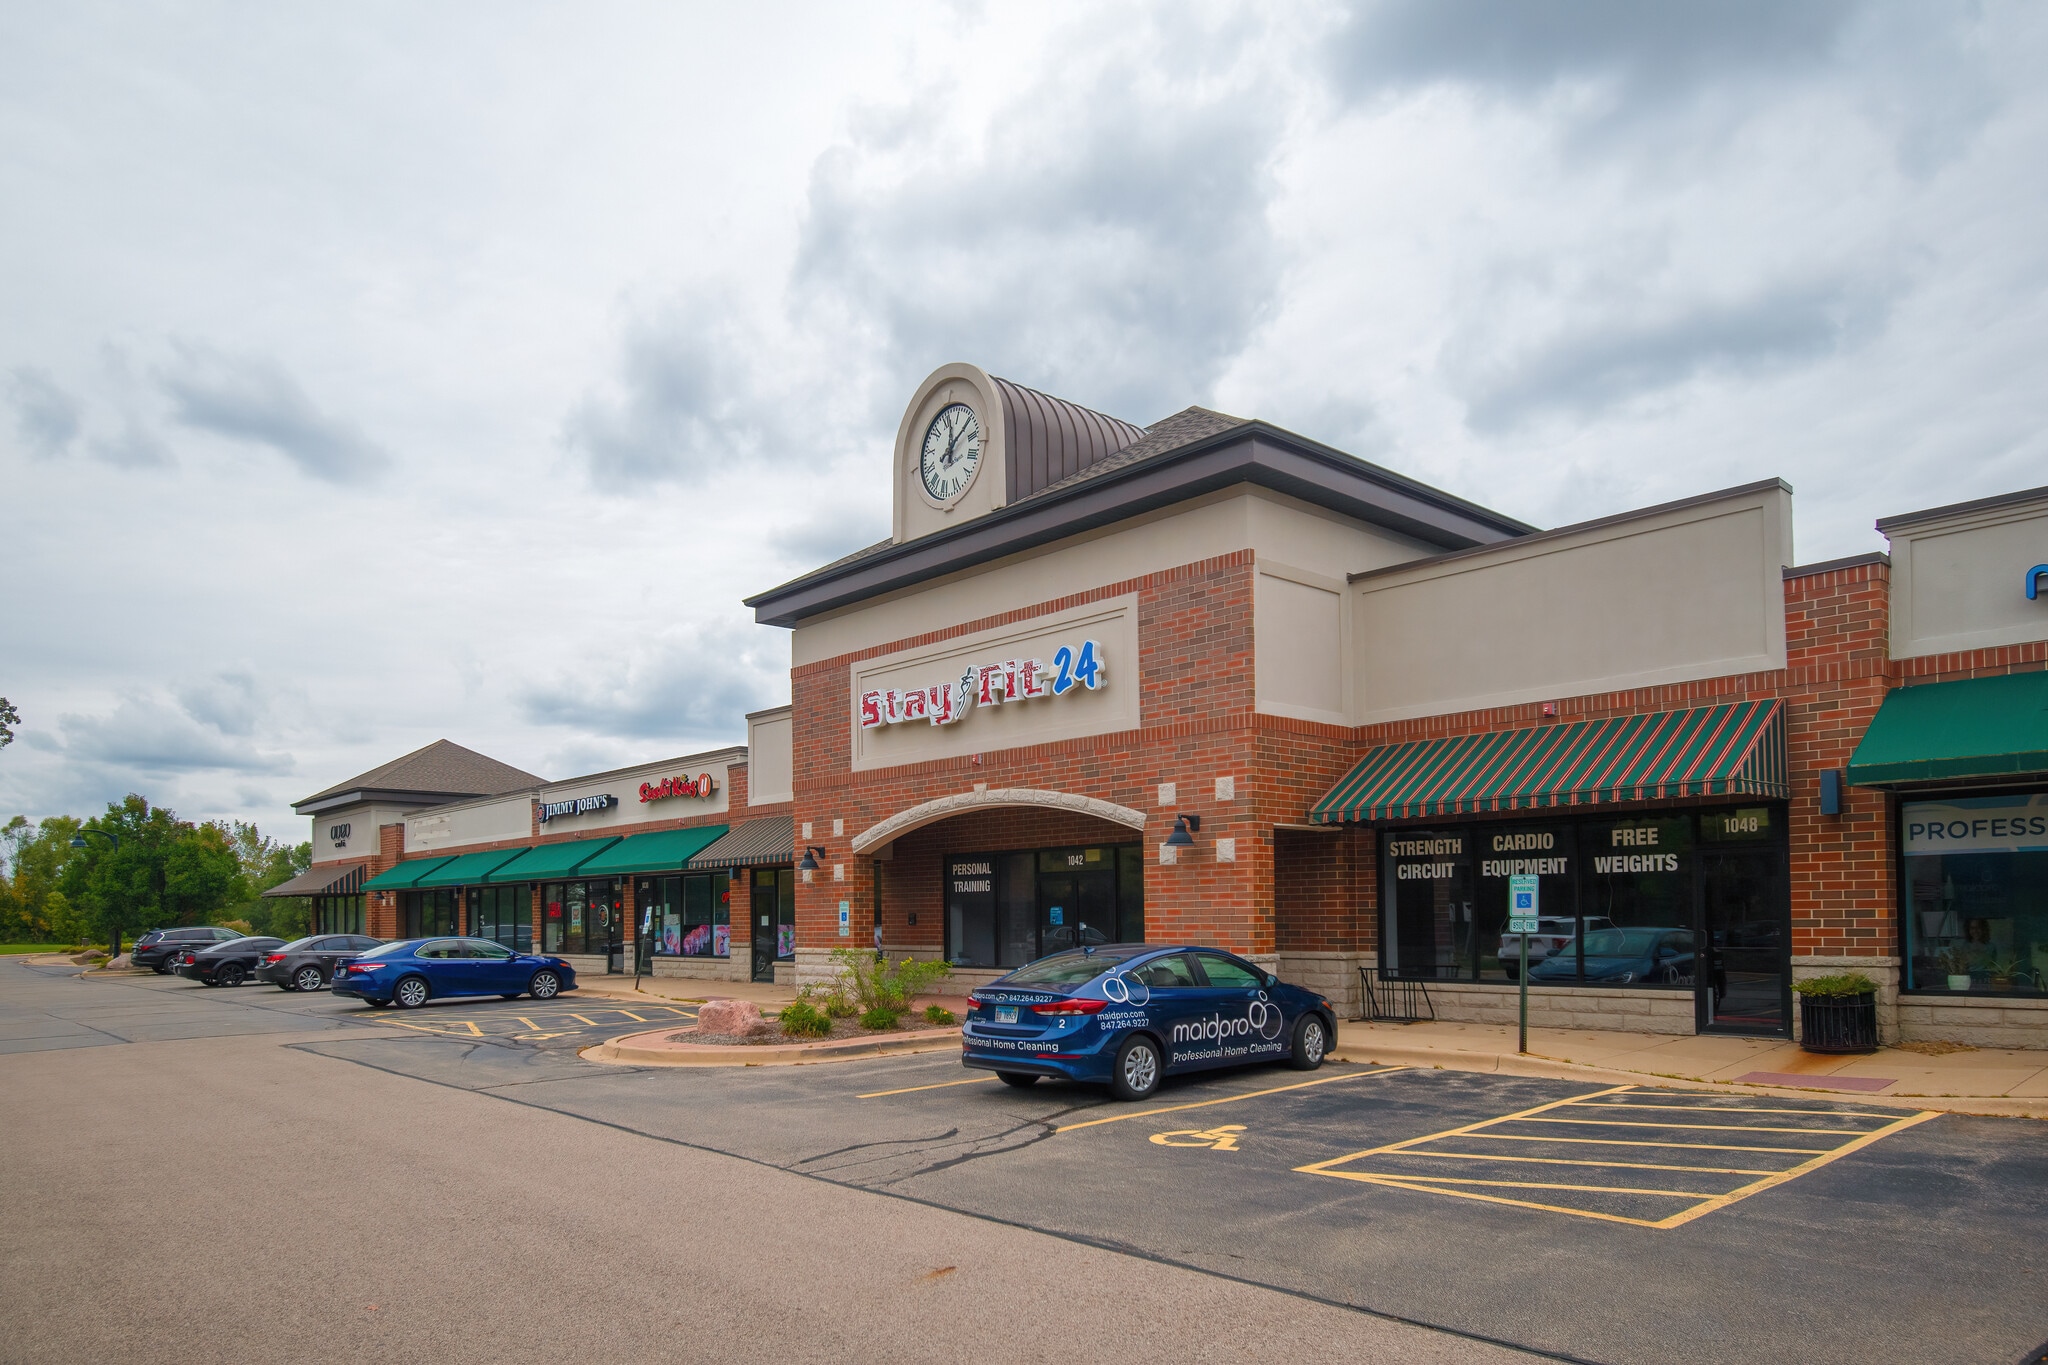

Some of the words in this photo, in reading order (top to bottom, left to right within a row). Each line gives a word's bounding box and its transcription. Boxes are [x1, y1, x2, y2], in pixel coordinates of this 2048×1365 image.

[860, 683, 953, 730] Stay
[976, 658, 1044, 708] Fit
[1052, 639, 1101, 697] 24
[545, 800, 575, 820] JIMMY
[576, 794, 608, 816] JOHN'S
[1724, 817, 1758, 833] 1048
[1909, 817, 2046, 841] PROFESS
[1492, 832, 1554, 852] CARDIO
[1611, 827, 1659, 847] FREE
[1390, 838, 1462, 857] STRENGTH
[952, 862, 992, 876] PERSONAL
[1067, 855, 1084, 866] 1042
[1482, 857, 1568, 878] EQUIPMENT
[1594, 853, 1679, 874] WEIGHTS
[1397, 862, 1455, 880] CIRCUIT
[953, 880, 991, 893] TRAINING
[1009, 994, 1053, 1003] 847.264.9227
[1058, 1018, 1066, 1029] 2
[1097, 1010, 1146, 1021] maidpro.com
[1100, 1018, 1150, 1031] 847.264.9227
[1173, 1012, 1249, 1046] maidpro
[992, 1039, 1016, 1050] Home
[1017, 1041, 1059, 1053] Cleaning
[1173, 1047, 1223, 1063] Professional
[1224, 1045, 1248, 1057] Home
[1249, 1041, 1282, 1053] Cleaning
